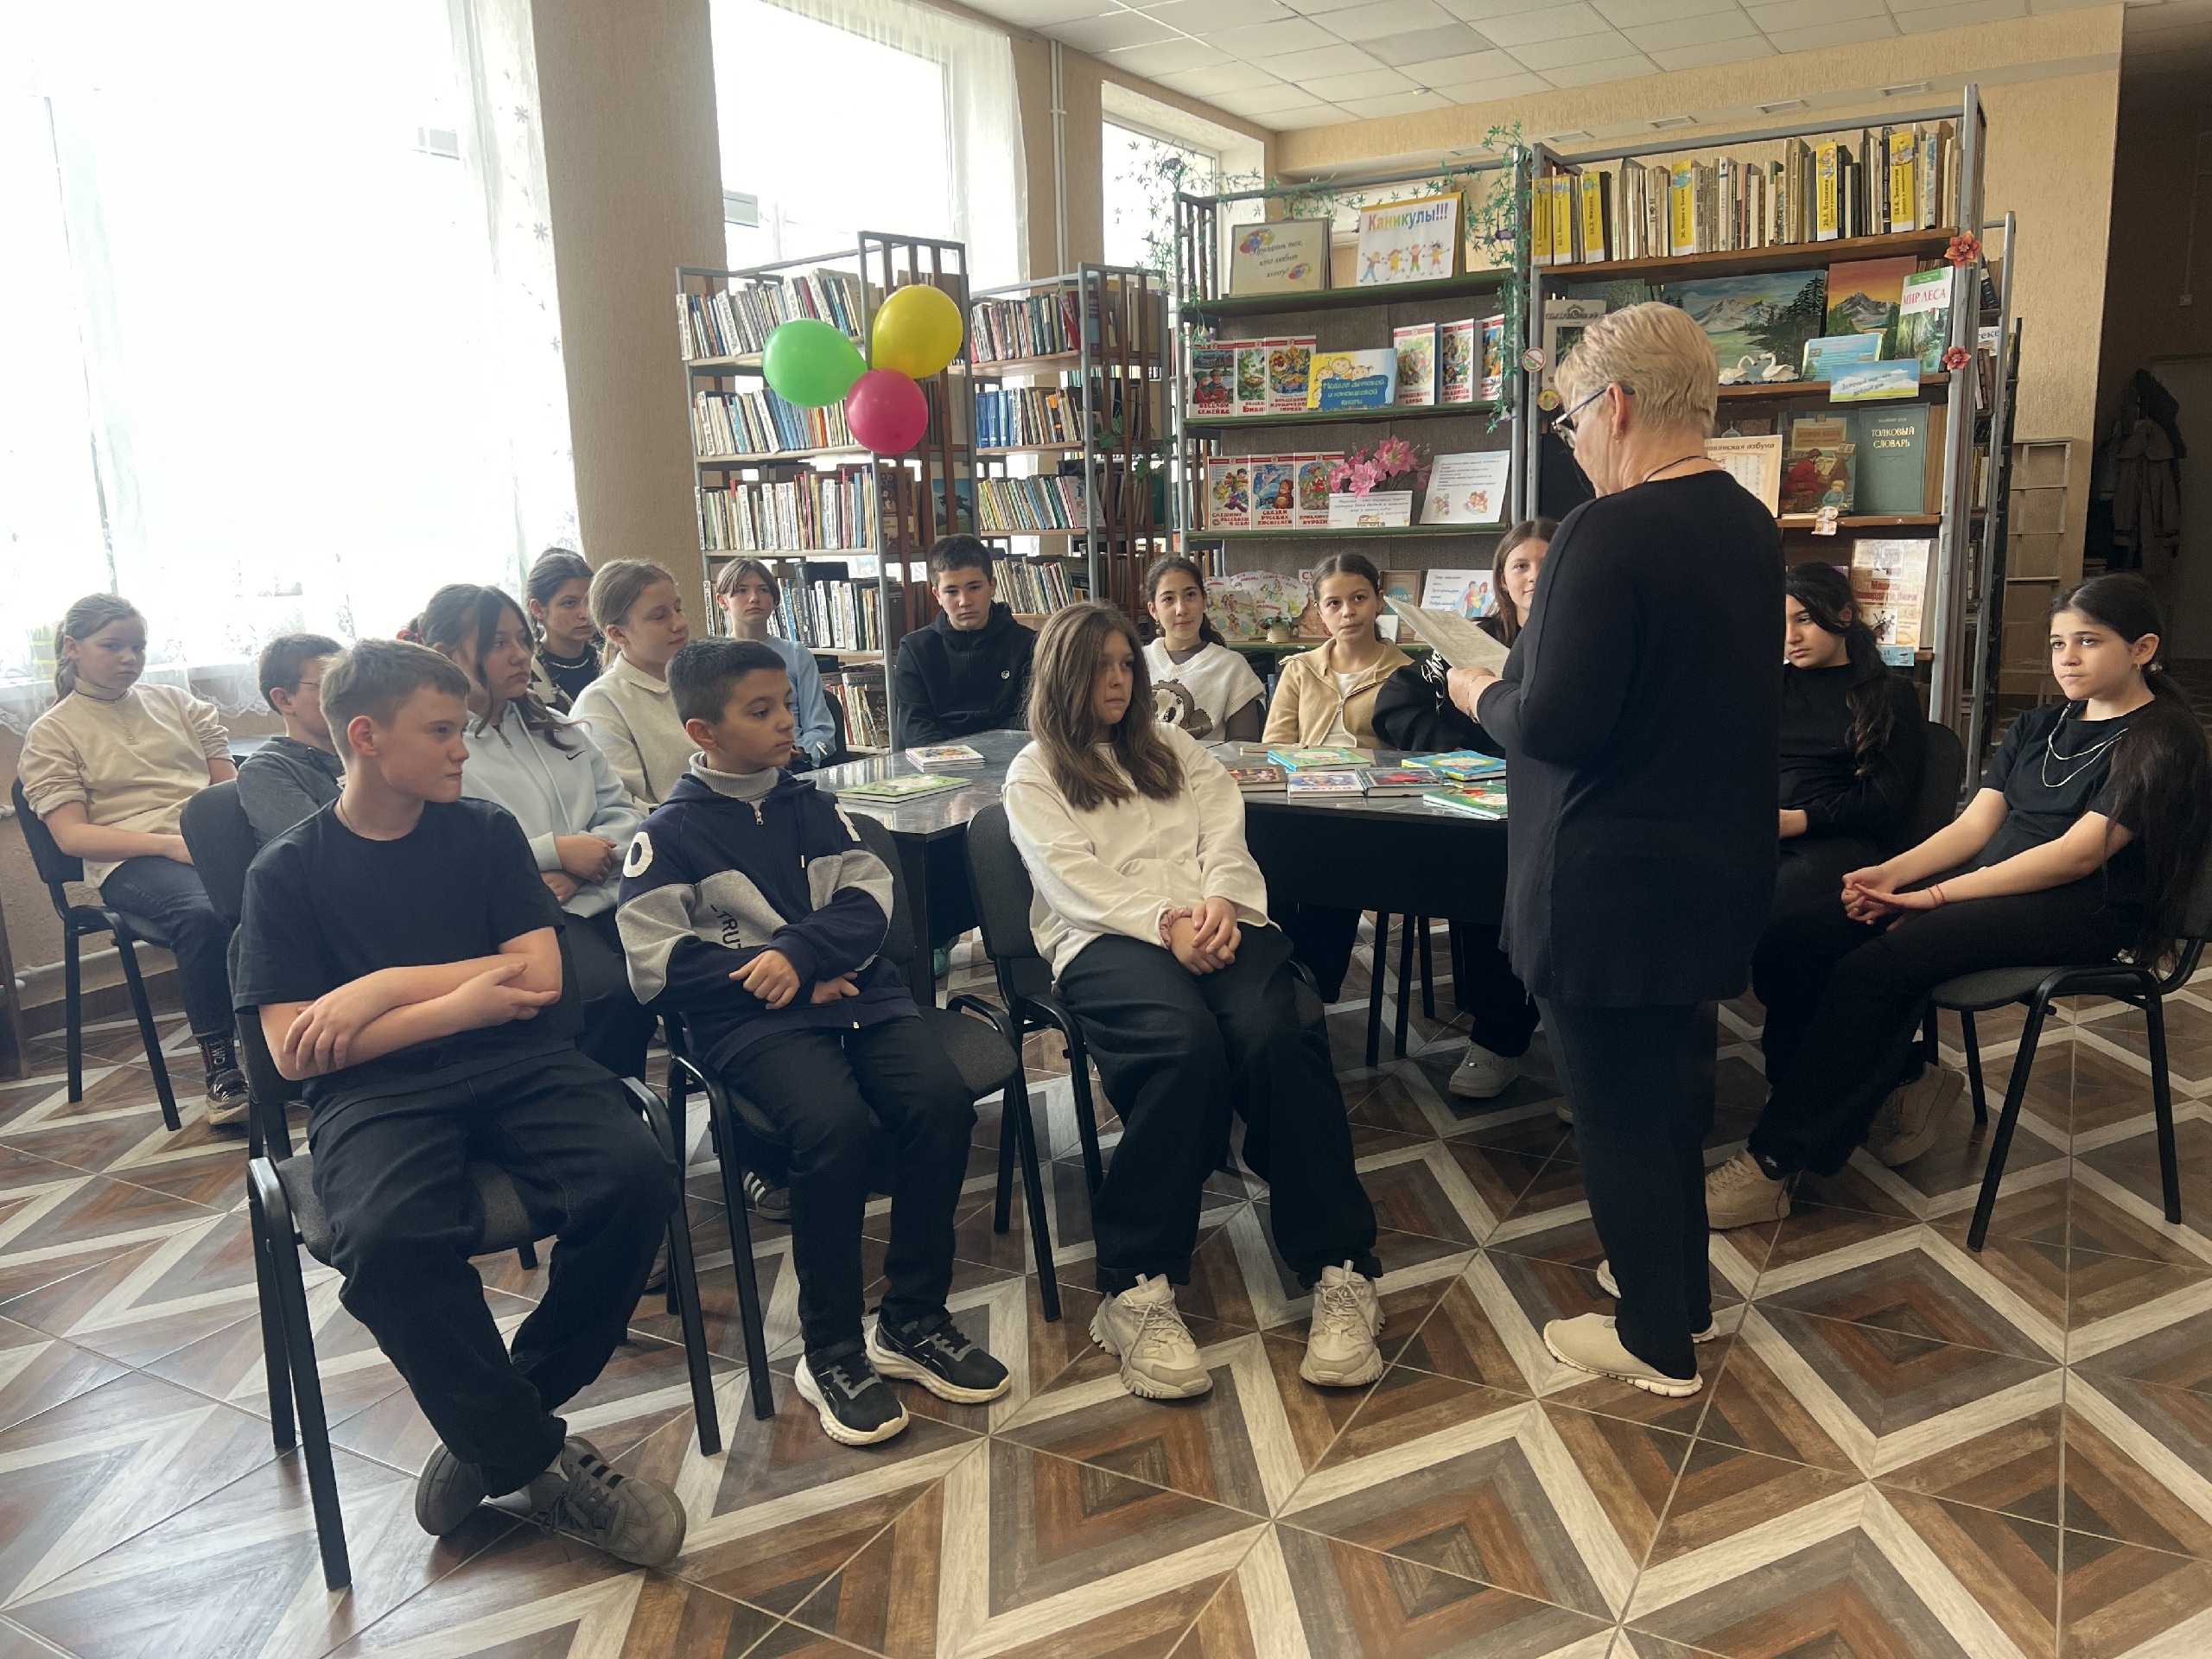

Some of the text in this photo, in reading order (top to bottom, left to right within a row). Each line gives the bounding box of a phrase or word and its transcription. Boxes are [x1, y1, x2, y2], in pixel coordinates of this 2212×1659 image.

[1368, 202, 1449, 231] Каникулы!!!
[1903, 288, 1946, 305] МИР ЛЕСА
[1871, 425, 1915, 438] ТОЛКОВЫЙ
[1746, 442, 1775, 450] азбука
[1872, 438, 1910, 448] СЛОВАРЬ
